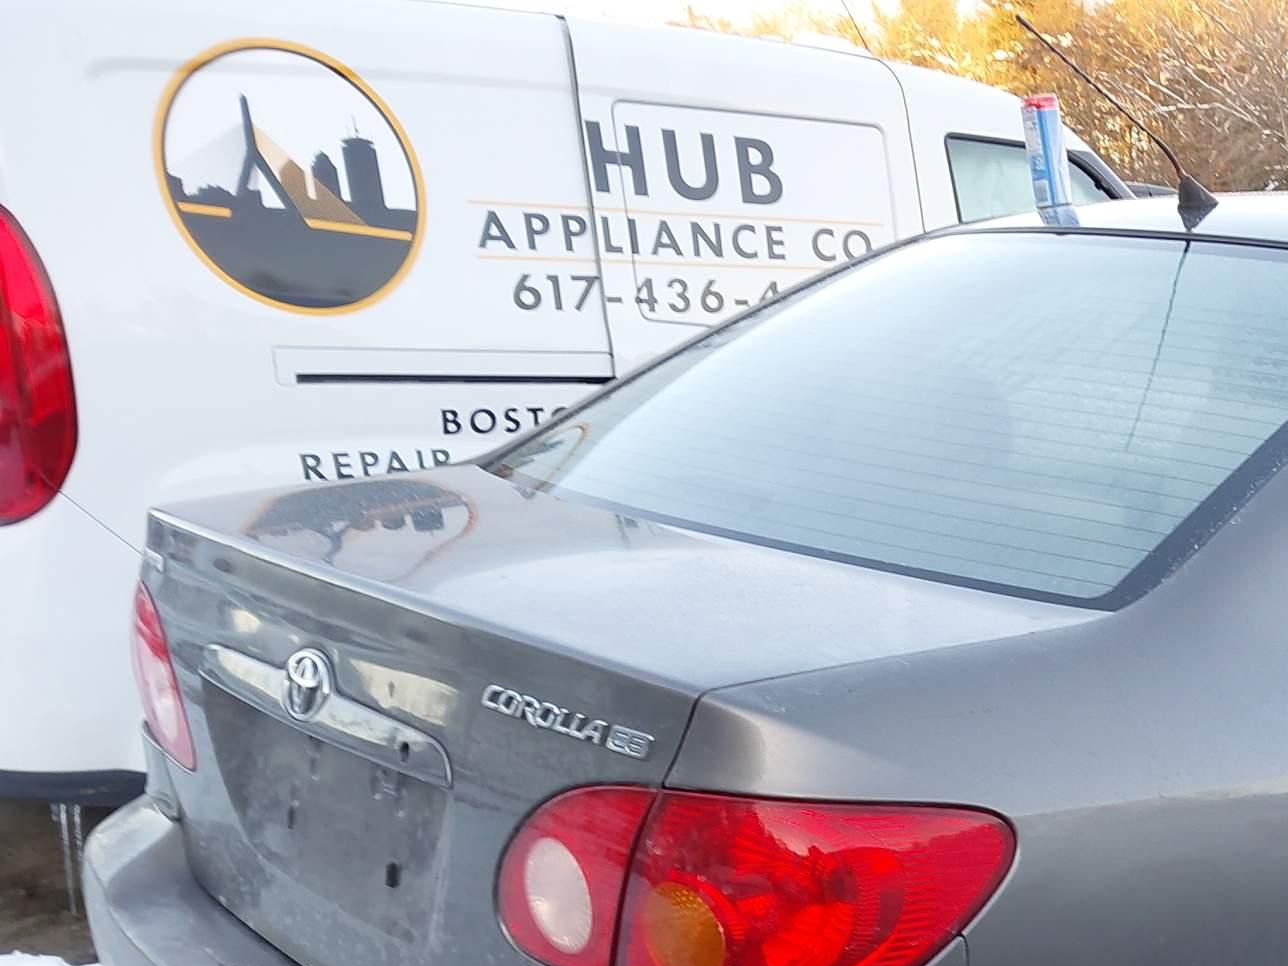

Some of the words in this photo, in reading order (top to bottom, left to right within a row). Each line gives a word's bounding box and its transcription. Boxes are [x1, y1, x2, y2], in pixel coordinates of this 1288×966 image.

[585, 120, 784, 205] HUB
[478, 210, 786, 260] APPLIANCE
[441, 406, 568, 435] BOST
[481, 684, 608, 745] COROLLA
